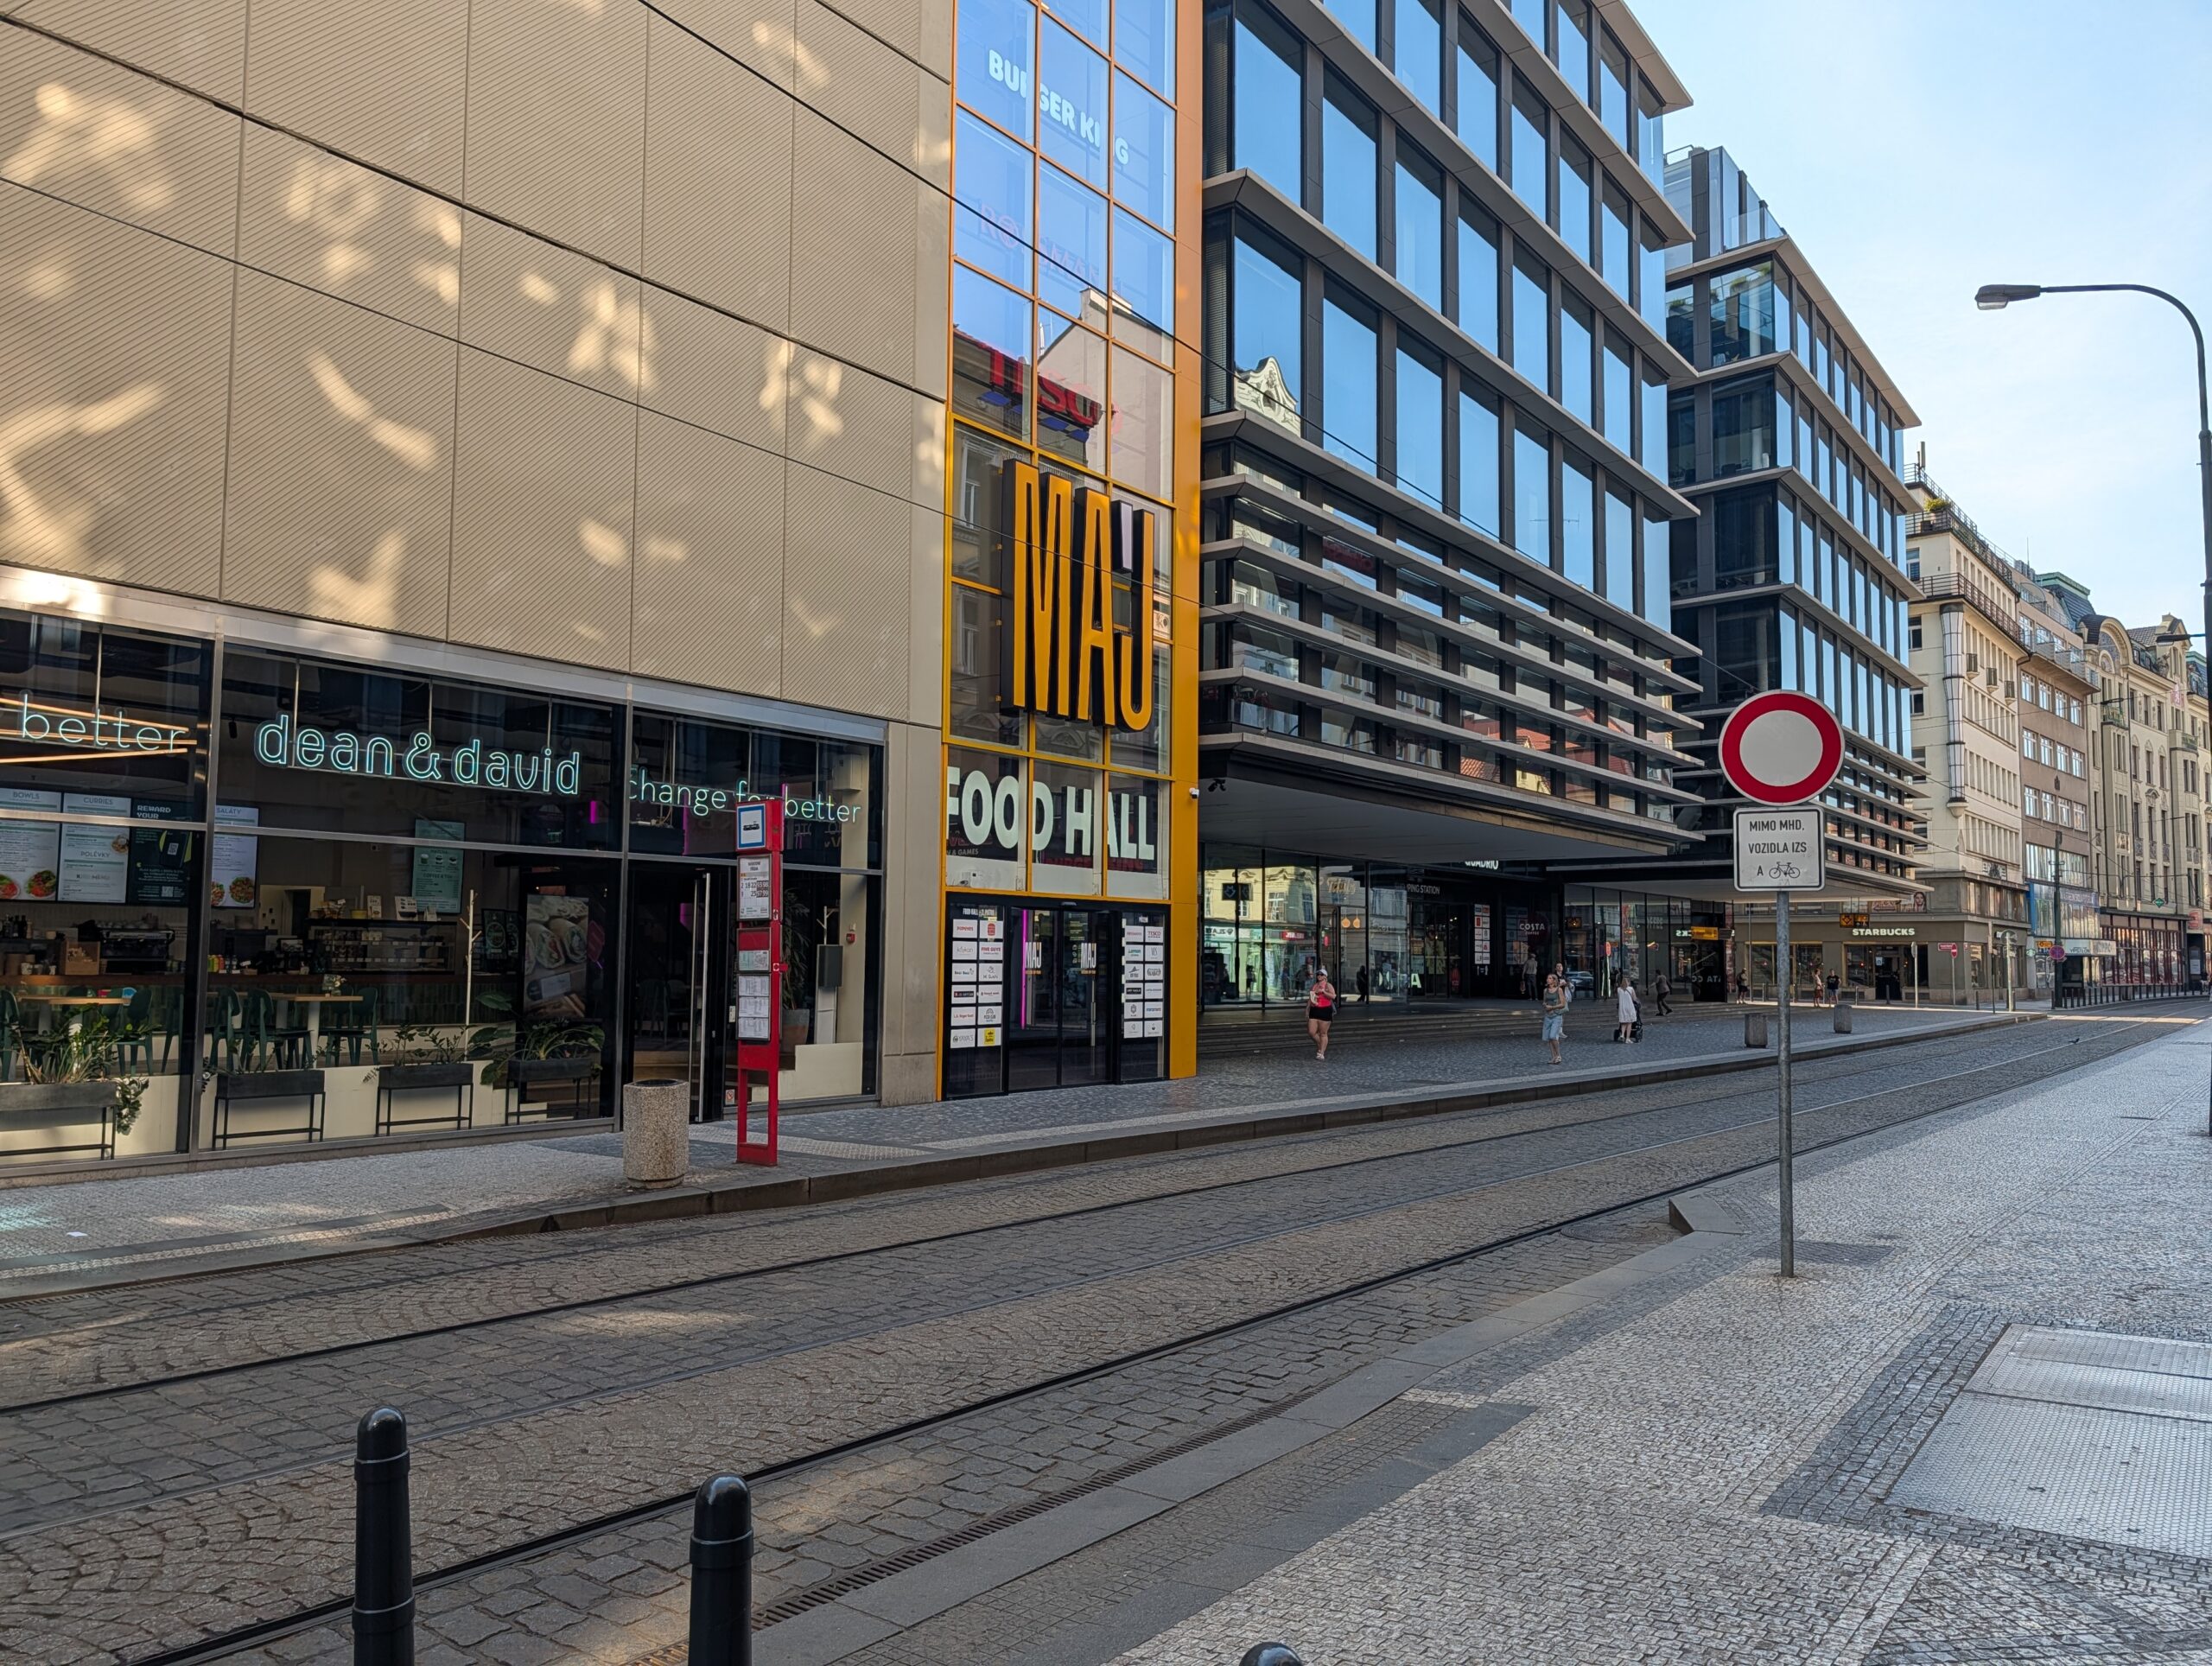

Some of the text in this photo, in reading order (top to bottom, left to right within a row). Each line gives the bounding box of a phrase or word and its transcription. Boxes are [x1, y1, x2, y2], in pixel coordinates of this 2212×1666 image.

[1080, 111, 1129, 165] KIG
[22, 693, 187, 751] better
[257, 714, 580, 795] dean & david
[83, 797, 113, 805] CURRIES
[629, 769, 727, 817] change
[785, 785, 861, 823] better
[137, 804, 171, 813] REWARD
[946, 766, 1054, 851] FOOD
[1749, 821, 1777, 832] MIMO
[1748, 842, 1807, 855] VOZIDLA IZS
[1757, 865, 1764, 876] A
[1420, 884, 1440, 895] STATION
